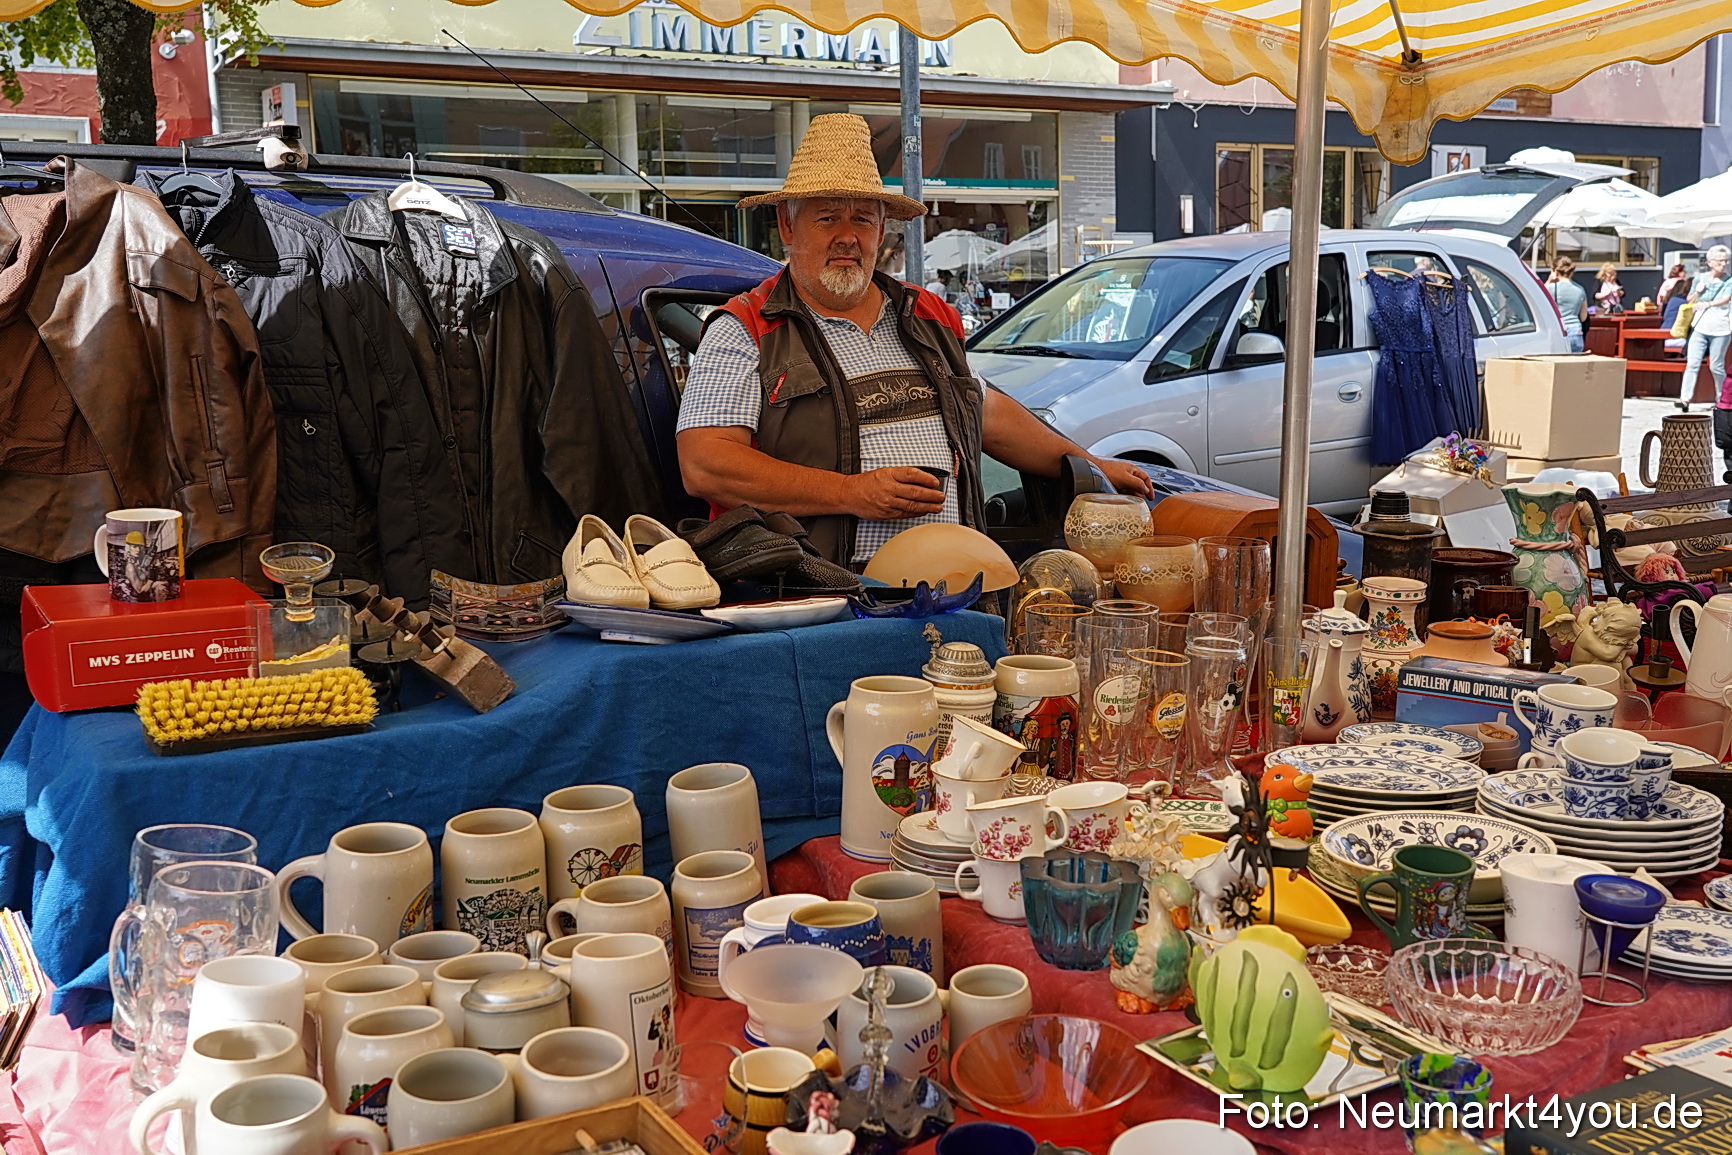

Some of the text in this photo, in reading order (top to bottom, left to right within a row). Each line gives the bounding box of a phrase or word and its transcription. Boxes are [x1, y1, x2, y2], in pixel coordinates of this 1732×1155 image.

[573, 11, 953, 67] ZIMMERMAN
[88, 648, 195, 668] MVS ZEPPELIN
[208, 647, 219, 655] CAT
[1402, 672, 1451, 691] JEWELLERY
[1452, 679, 1471, 695] AND
[1472, 681, 1509, 700] OPTICAL
[905, 729, 926, 744] Gans
